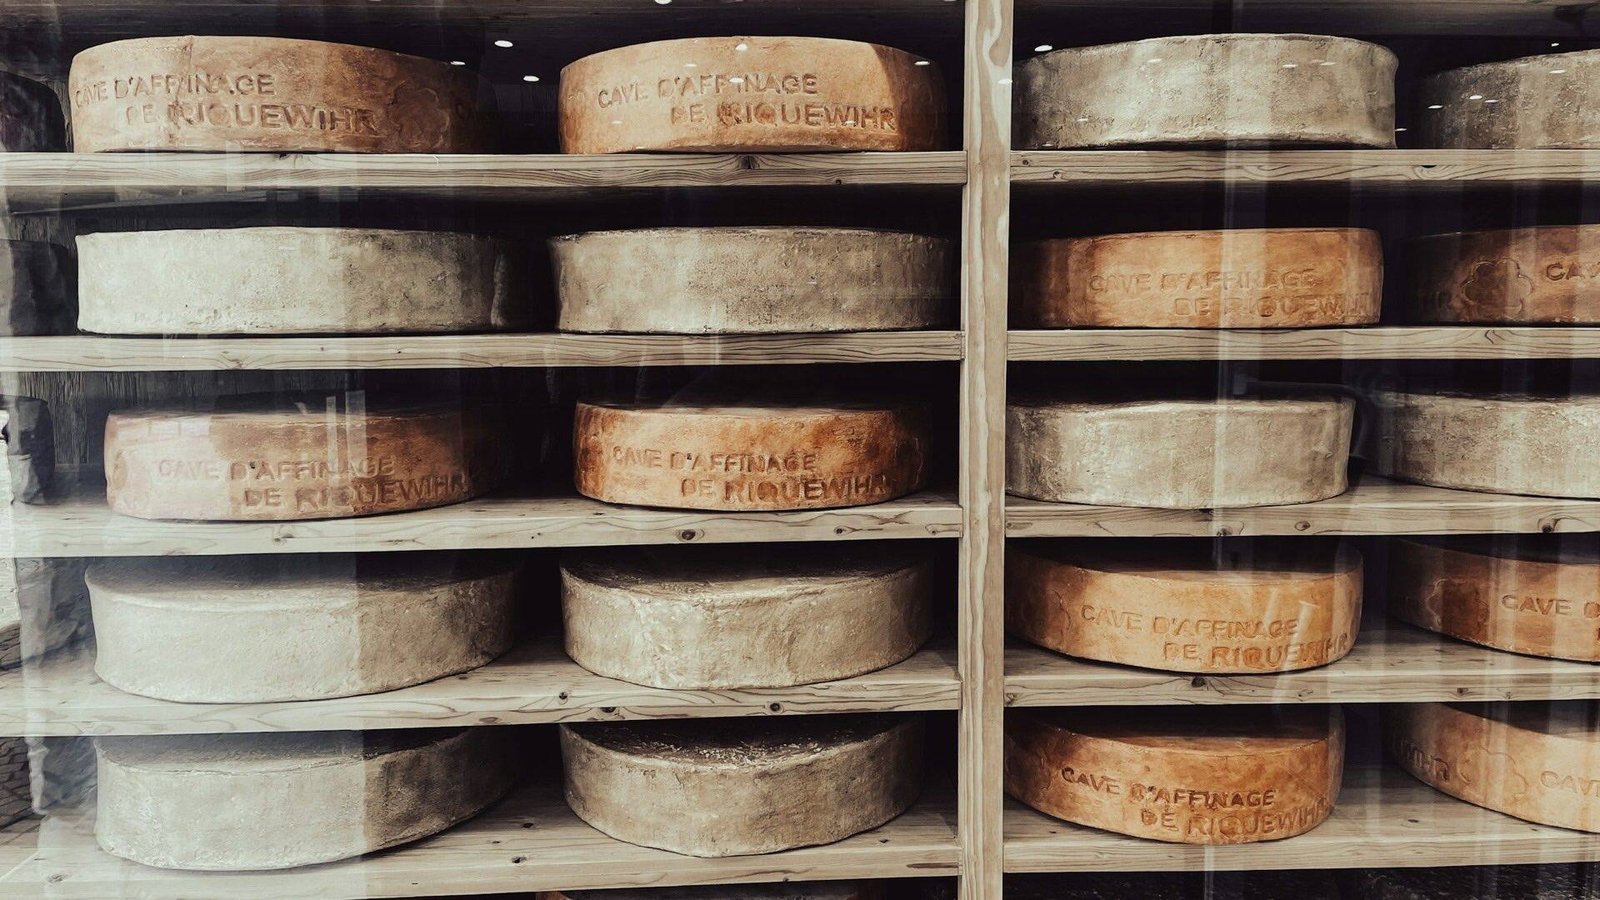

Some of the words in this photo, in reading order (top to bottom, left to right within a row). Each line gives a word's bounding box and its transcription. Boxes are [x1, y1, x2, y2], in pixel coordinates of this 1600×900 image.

[75, 80, 109, 108] CAVE
[597, 82, 647, 109] CAVE
[125, 103, 156, 126] DE
[670, 103, 705, 126] DE
[716, 102, 898, 132] RIQUEWIHR
[1089, 273, 1152, 294] CAVE
[1173, 297, 1210, 318] DE
[158, 459, 220, 480] CAVE
[612, 445, 662, 468] CAVE
[669, 451, 818, 474] D'AFFINAGE
[243, 487, 283, 508] DE
[680, 478, 713, 499] DE
[724, 474, 888, 501] RIQUEWIHR
[1501, 594, 1572, 616] CAVE
[1081, 604, 1145, 633] CAVE
[1152, 616, 1298, 640] D'AFFINAGE
[1163, 640, 1200, 662] DE
[1061, 766, 1121, 796] CAVE
[1129, 782, 1276, 812] D'AFFINAGE
[1140, 809, 1179, 830] DE
